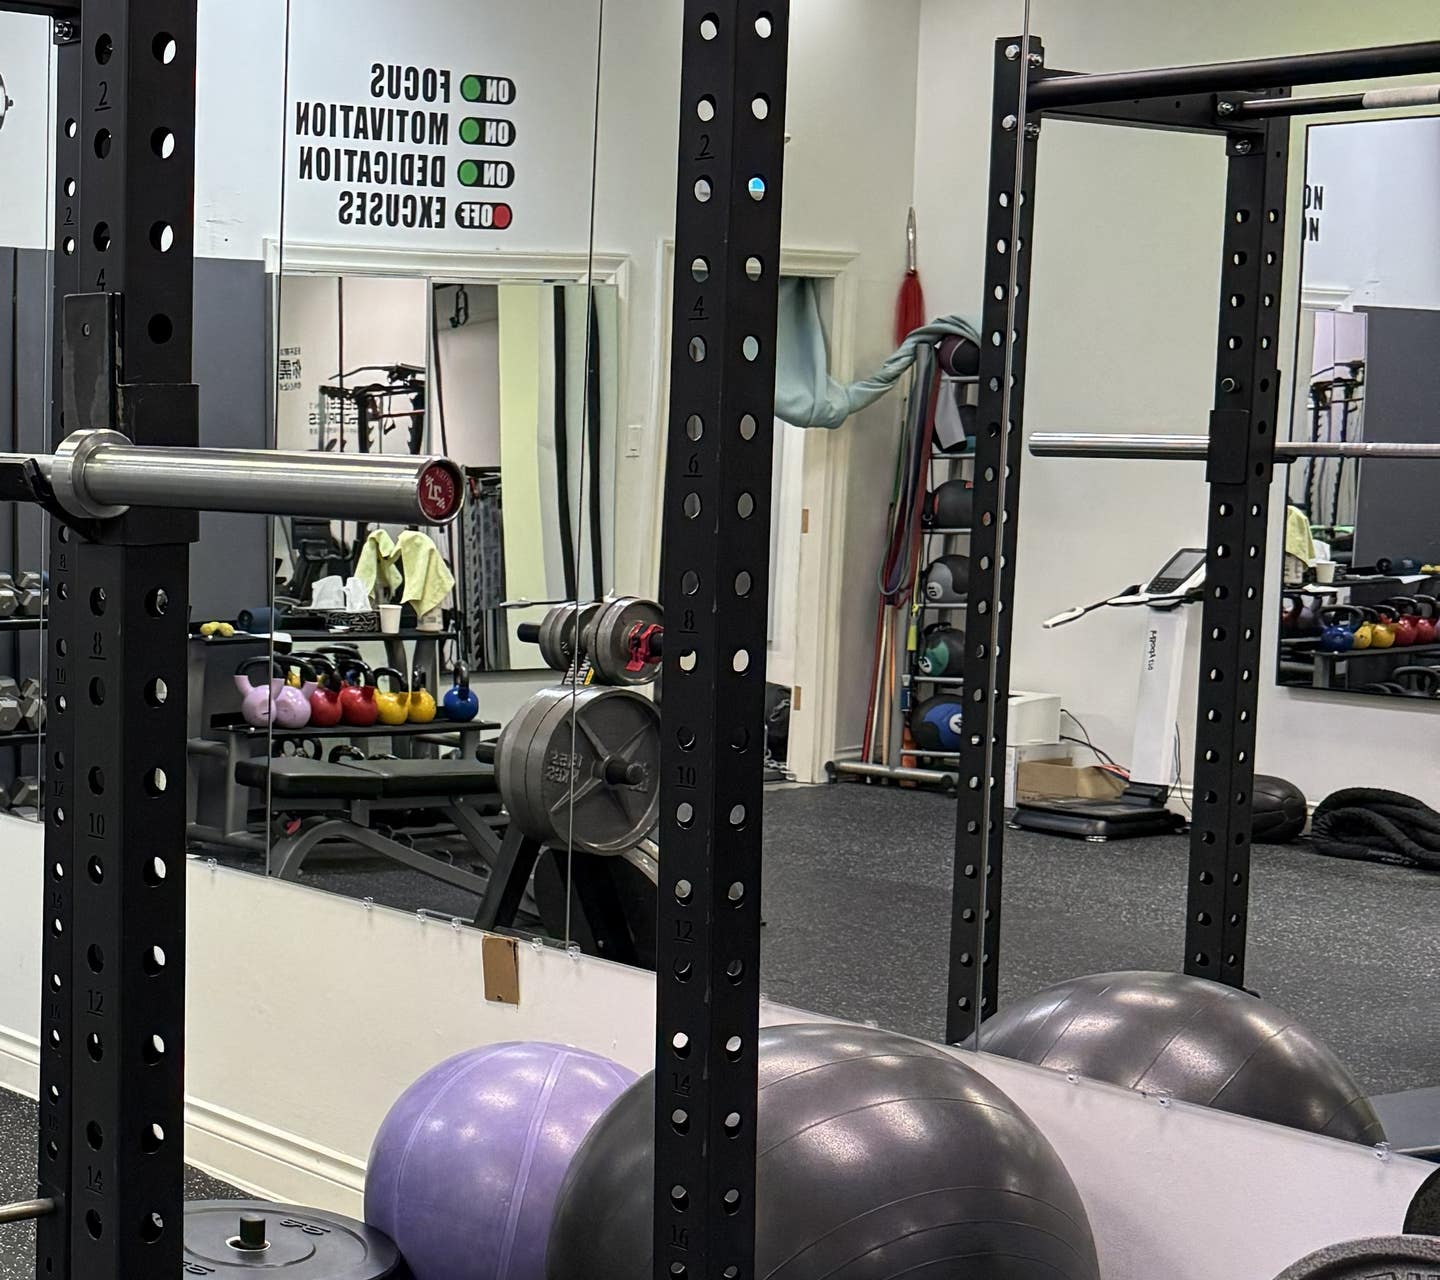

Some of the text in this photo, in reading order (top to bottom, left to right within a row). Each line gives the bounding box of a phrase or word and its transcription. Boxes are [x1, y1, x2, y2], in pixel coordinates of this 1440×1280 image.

[98, 81, 108, 106] 2
[700, 135, 710, 157] 2
[693, 296, 705, 317] 4
[688, 453, 699, 474] 6
[684, 609, 695, 630] 8
[93, 632, 103, 655] 8
[677, 767, 696, 786] 10
[89, 812, 105, 835] 10
[675, 920, 693, 940] 12
[88, 990, 104, 1012] 12
[671, 1073, 691, 1094] 14
[87, 1166, 103, 1191] 14
